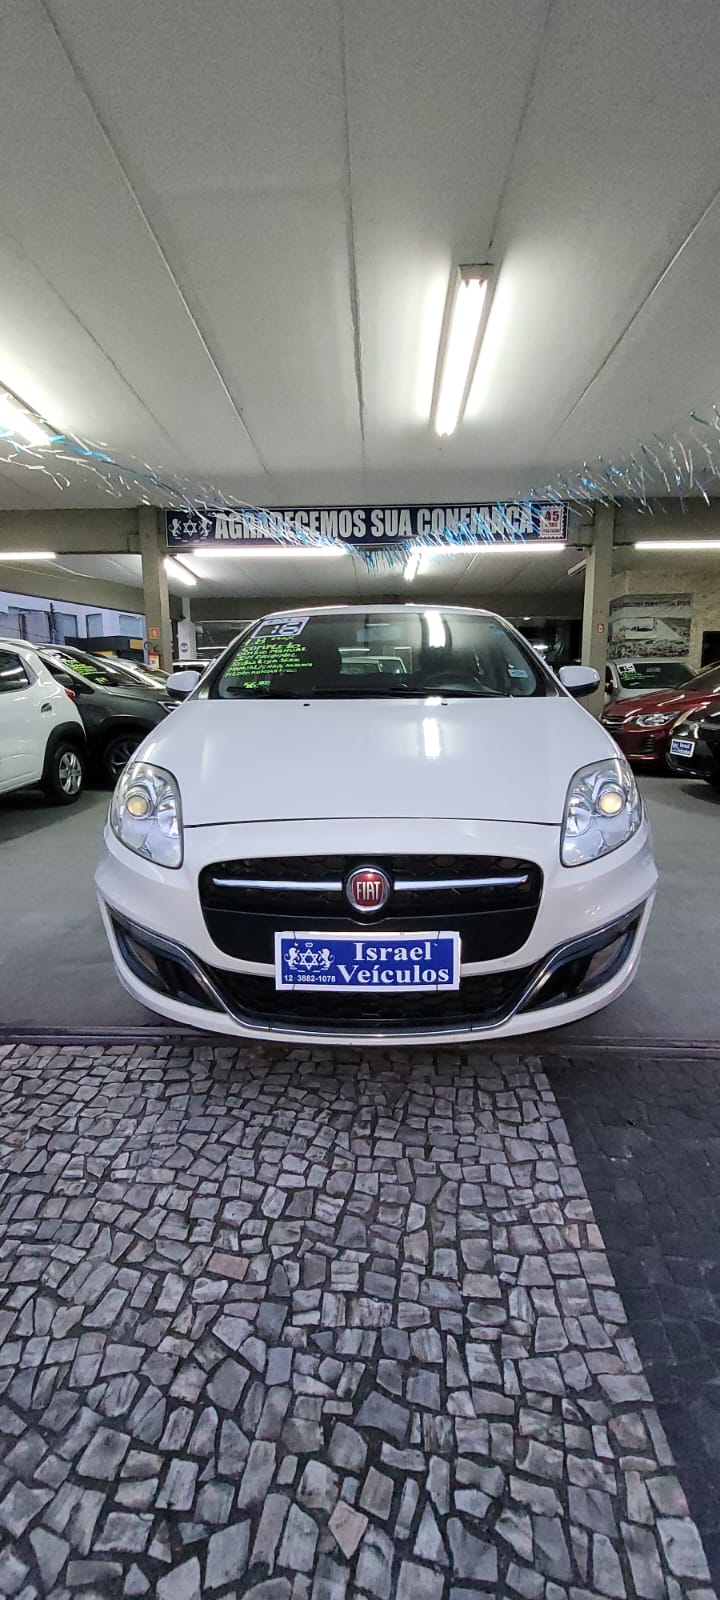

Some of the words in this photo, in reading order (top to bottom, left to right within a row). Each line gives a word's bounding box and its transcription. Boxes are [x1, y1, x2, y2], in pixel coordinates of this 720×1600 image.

[370, 508, 413, 537] SUA
[545, 510, 560, 521] 45
[356, 881, 381, 900] FIAT
[353, 941, 432, 961] Israel
[284, 974, 294, 982] 12
[297, 974, 336, 982] 3882-1078
[336, 964, 449, 983] Veículos
